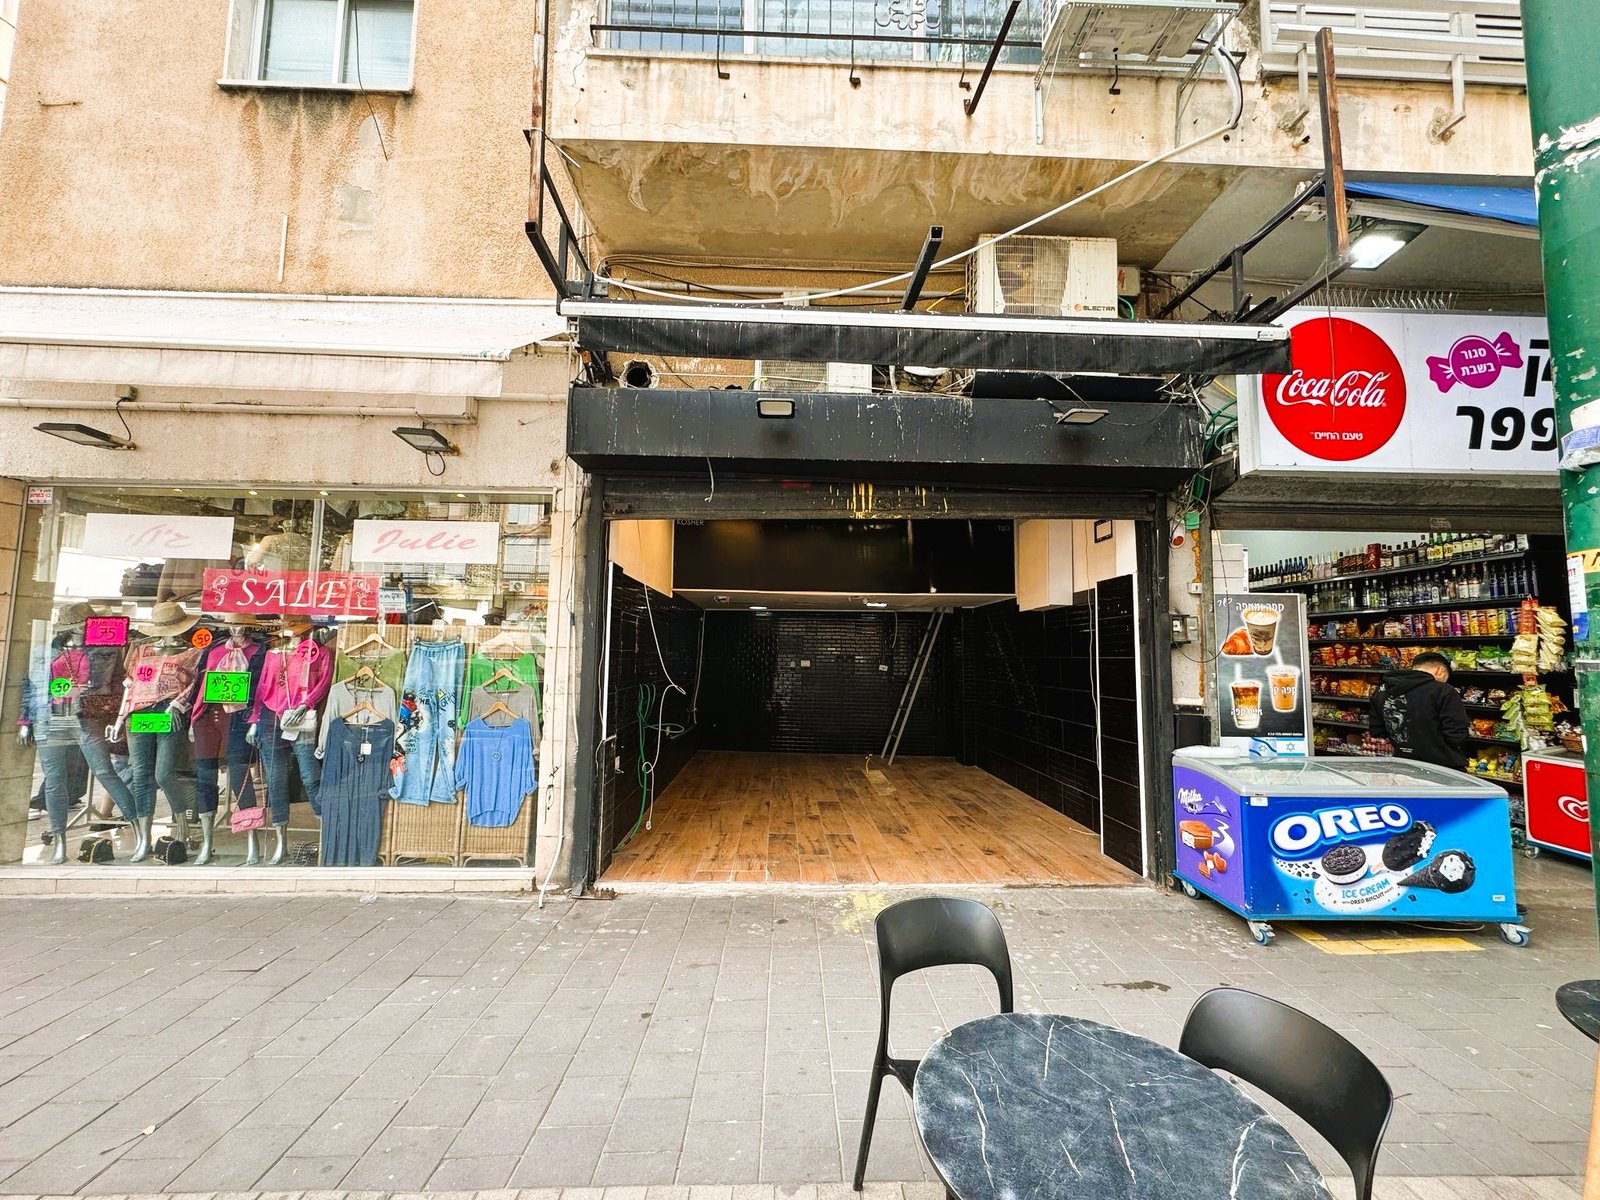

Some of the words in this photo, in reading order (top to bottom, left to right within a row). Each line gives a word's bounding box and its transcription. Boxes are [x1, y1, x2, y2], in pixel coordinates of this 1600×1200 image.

[1461, 347, 1487, 360] סגור
[1461, 362, 1496, 377] בשבת
[1276, 369, 1391, 408] Coca-Cola
[1314, 432, 1340, 441] החיים
[1342, 432, 1364, 441] טעם
[372, 528, 479, 554] Julie
[236, 578, 347, 608] SALE
[1266, 603, 1285, 612] קפה
[97, 627, 116, 640] 75
[222, 681, 241, 692] 50
[1281, 686, 1297, 695] קפה
[1178, 787, 1203, 805] Milka
[1273, 804, 1409, 851] OREO
[1342, 890, 1357, 899] ICE
[1359, 878, 1390, 896] CREAM
[1365, 891, 1385, 903] BISCUIT
